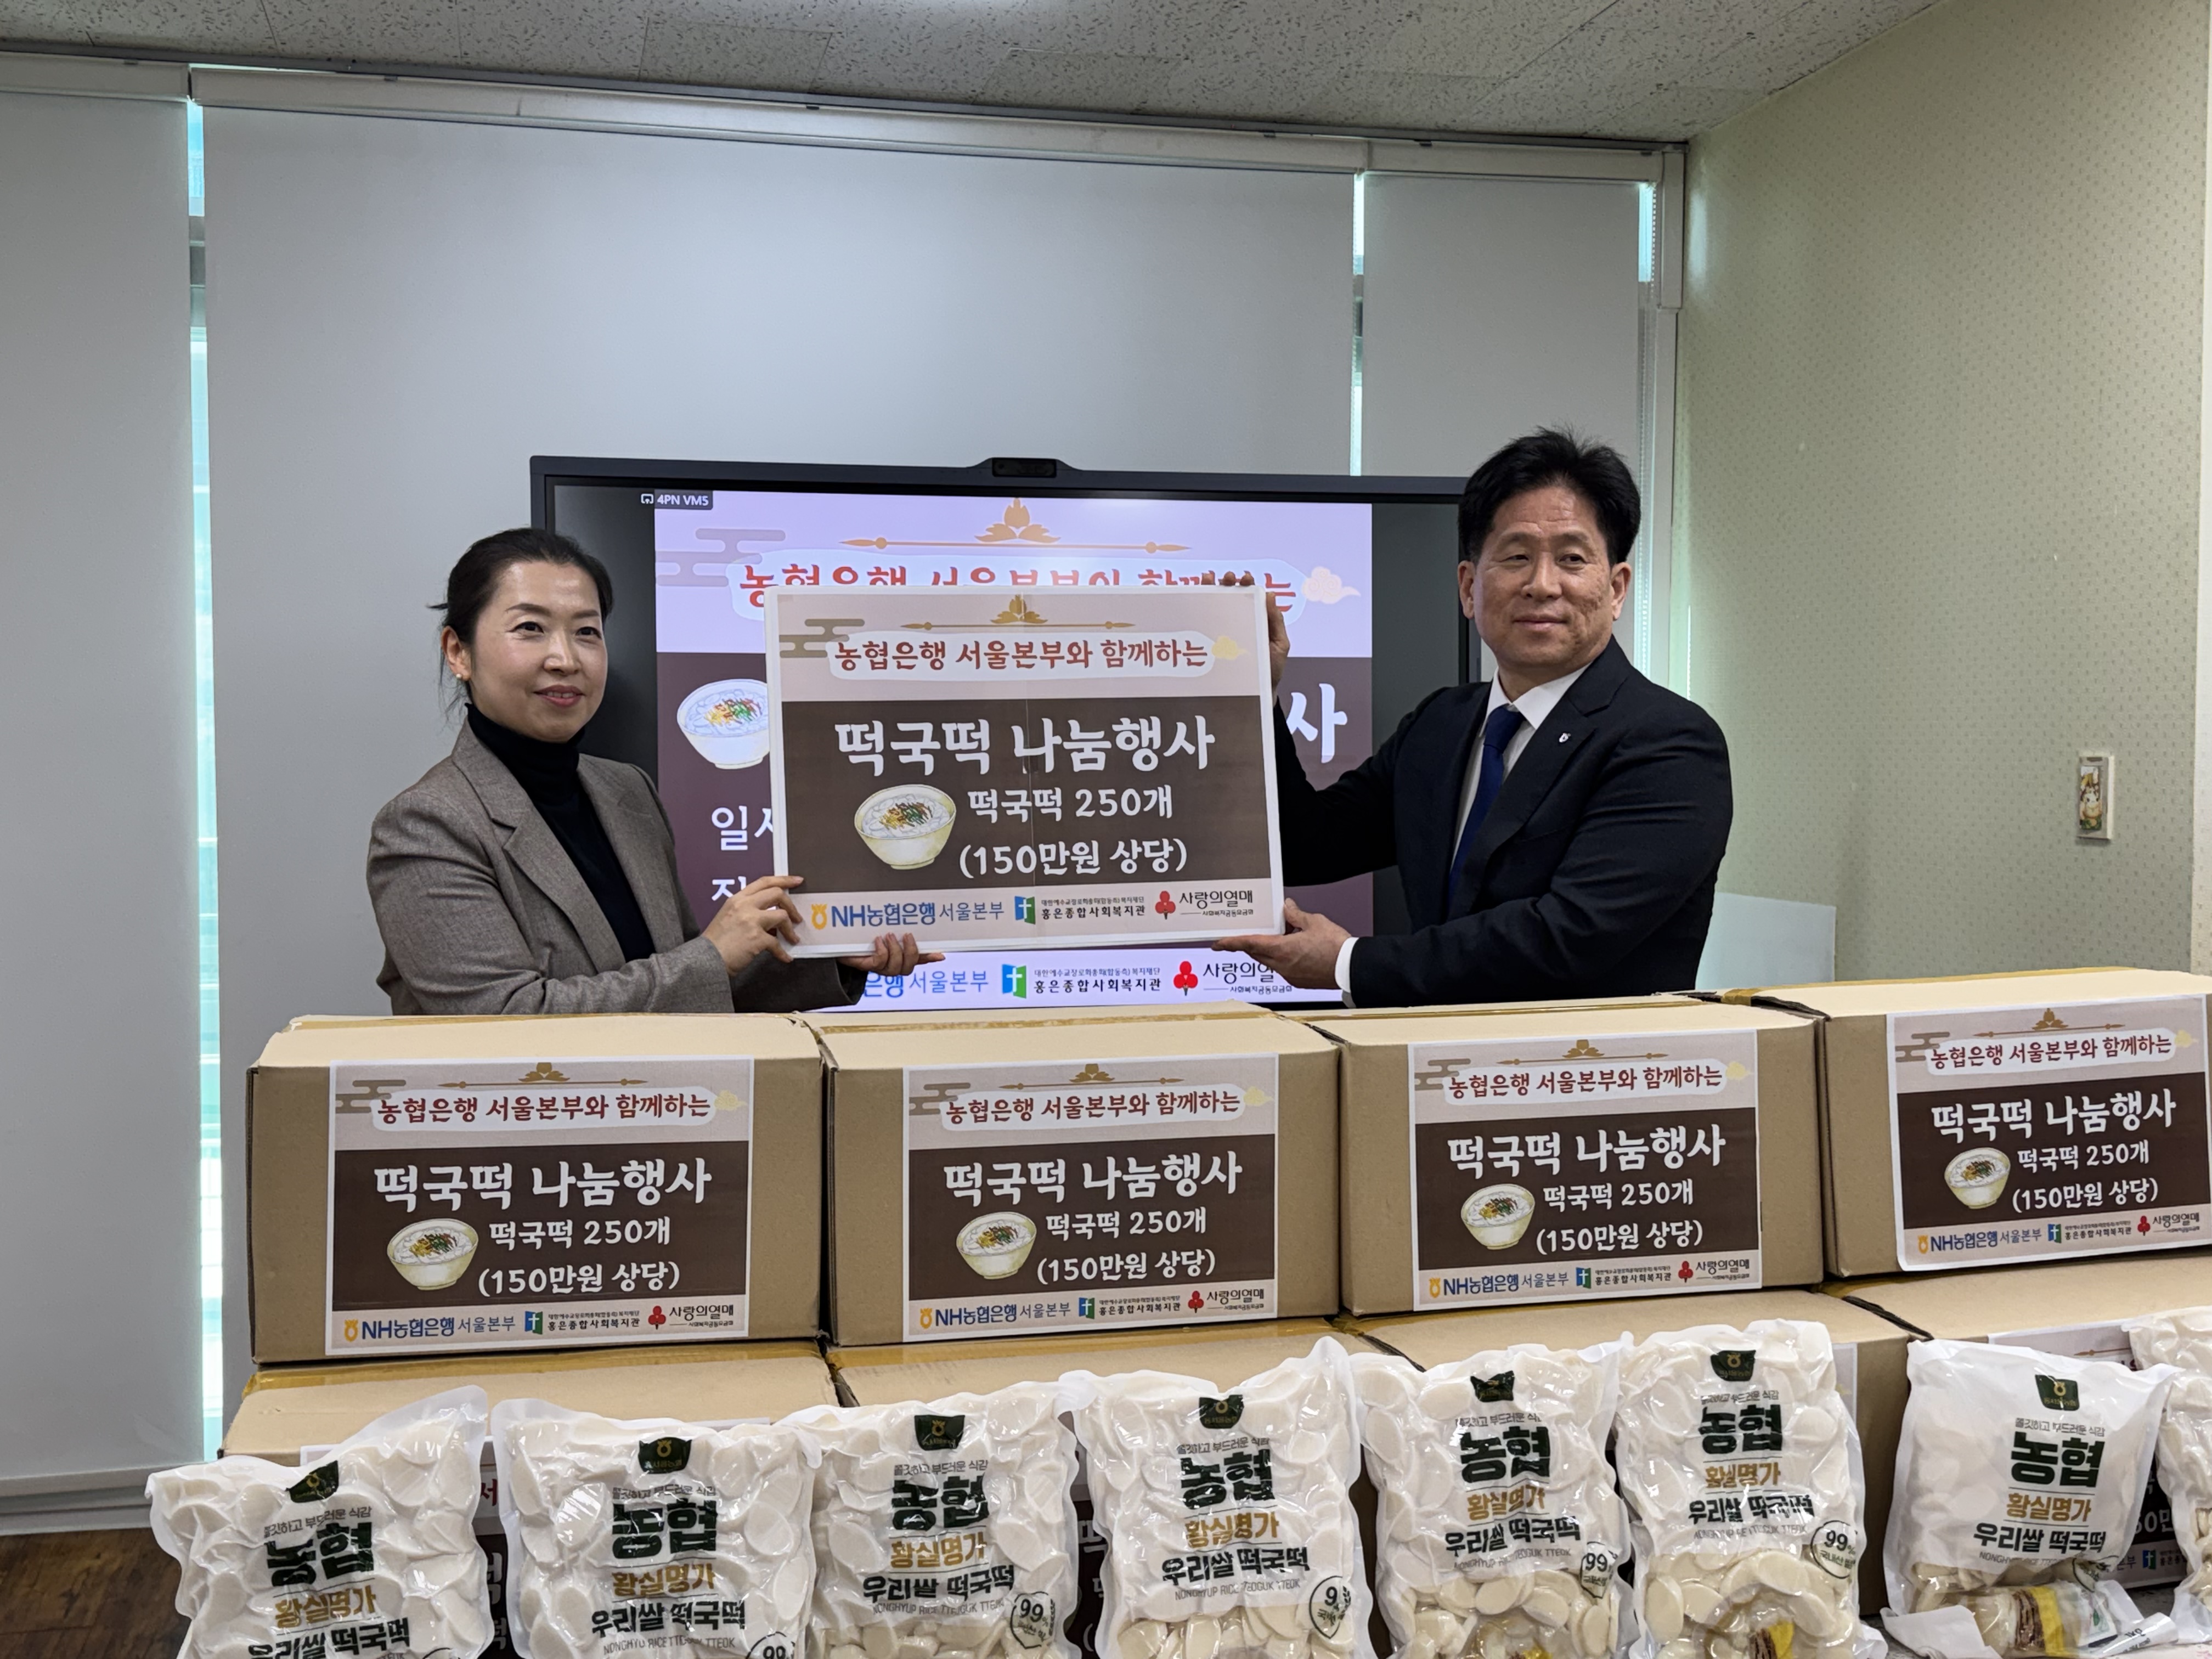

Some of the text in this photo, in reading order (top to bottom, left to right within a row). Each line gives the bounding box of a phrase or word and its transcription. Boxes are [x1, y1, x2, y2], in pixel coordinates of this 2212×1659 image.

[657, 494, 681, 505] 4PN
[835, 639, 1208, 671] 농협은행 서울본부와 함께하는
[835, 715, 1215, 776] 떡국떡 나눔행사
[968, 787, 1173, 821] 떡국떡 250개
[959, 837, 1188, 879] (150만원 상당)
[831, 901, 1005, 928] NH농협은행 서울본부
[1041, 905, 1146, 920] 홍은종합사회복지관
[1179, 889, 1253, 910] 사랑의열매
[910, 970, 989, 994] 서울본부
[1034, 978, 1161, 994] 홍은종합사회복지관
[1930, 1034, 2172, 1070] 농협은행 서울본부와 함께하는
[1448, 1064, 1723, 1099] 농협은행 서울본부와 함께하는
[377, 1093, 711, 1125] 농협은행 서울본부와 함께하는
[945, 1090, 1240, 1125] 농협은행 서울본부와 함께하는
[1931, 1088, 2176, 1144] 떡국떡 나눔행사
[1447, 1124, 1726, 1180] 떡국떡 나눔행사
[2017, 1139, 2149, 1173] 떡국떡 250개
[374, 1158, 712, 1212] 떡국떡 나눔행사
[943, 1150, 1243, 1207] 떡국떡 나눔행사
[1543, 1178, 1694, 1213] 떡국떡 250개
[2012, 1177, 2159, 1214] (150만원 상당)
[489, 1217, 672, 1251] 떡국떡 250개
[1045, 1206, 1207, 1242] 떡국떡 250개
[1536, 1220, 1703, 1256] (150만원 상당)
[1931, 1228, 2042, 1252] NH농협은행 서울본부
[478, 1261, 681, 1297] (150만원 상당)
[1037, 1248, 1216, 1285] (150만원 상당)
[1443, 1271, 1569, 1295] NH농협은행 서울본부
[669, 1304, 733, 1322] 사랑의열매
[934, 1301, 1071, 1327] NH농협은행 서울본부
[1206, 1288, 1265, 1305] 사랑의열매
[361, 1316, 516, 1340] NH농협은행 서울본부
[1762, 1390, 1779, 1400] 식감
[1212, 1437, 1249, 1453] 부드러운
[1698, 1404, 1782, 1454] 농협
[2088, 1426, 2106, 1437] 식감
[1459, 1426, 1551, 1483] 농협
[2011, 1431, 2105, 1488] 농협
[1181, 1448, 1276, 1510] 농협
[1704, 1462, 1781, 1489] 황실명가
[348, 1506, 373, 1518] 식감
[891, 1476, 989, 1531] 농협
[1466, 1484, 1545, 1522] 황실명가
[2006, 1492, 2092, 1523] 황실명가
[611, 1498, 717, 1560] 농협
[1184, 1511, 1279, 1549] 황실명가
[1444, 1516, 1581, 1558] 우리쌀 떡국떡
[1973, 1522, 2107, 1554] 우리쌀 떡국떡
[266, 1522, 375, 1587] 농협
[890, 1532, 988, 1569] 황실명가
[1161, 1547, 1311, 1585] 우리쌀 떡국떡
[1545, 1548, 1571, 1557] TTEOK
[611, 1562, 716, 1598] 황실명가
[862, 1565, 1015, 1604] 우리쌀 떡국떡
[275, 1585, 377, 1629] 황실명가
[591, 1600, 746, 1639] 우리쌀 떡국떡
[706, 1637, 736, 1649] TTEOK
